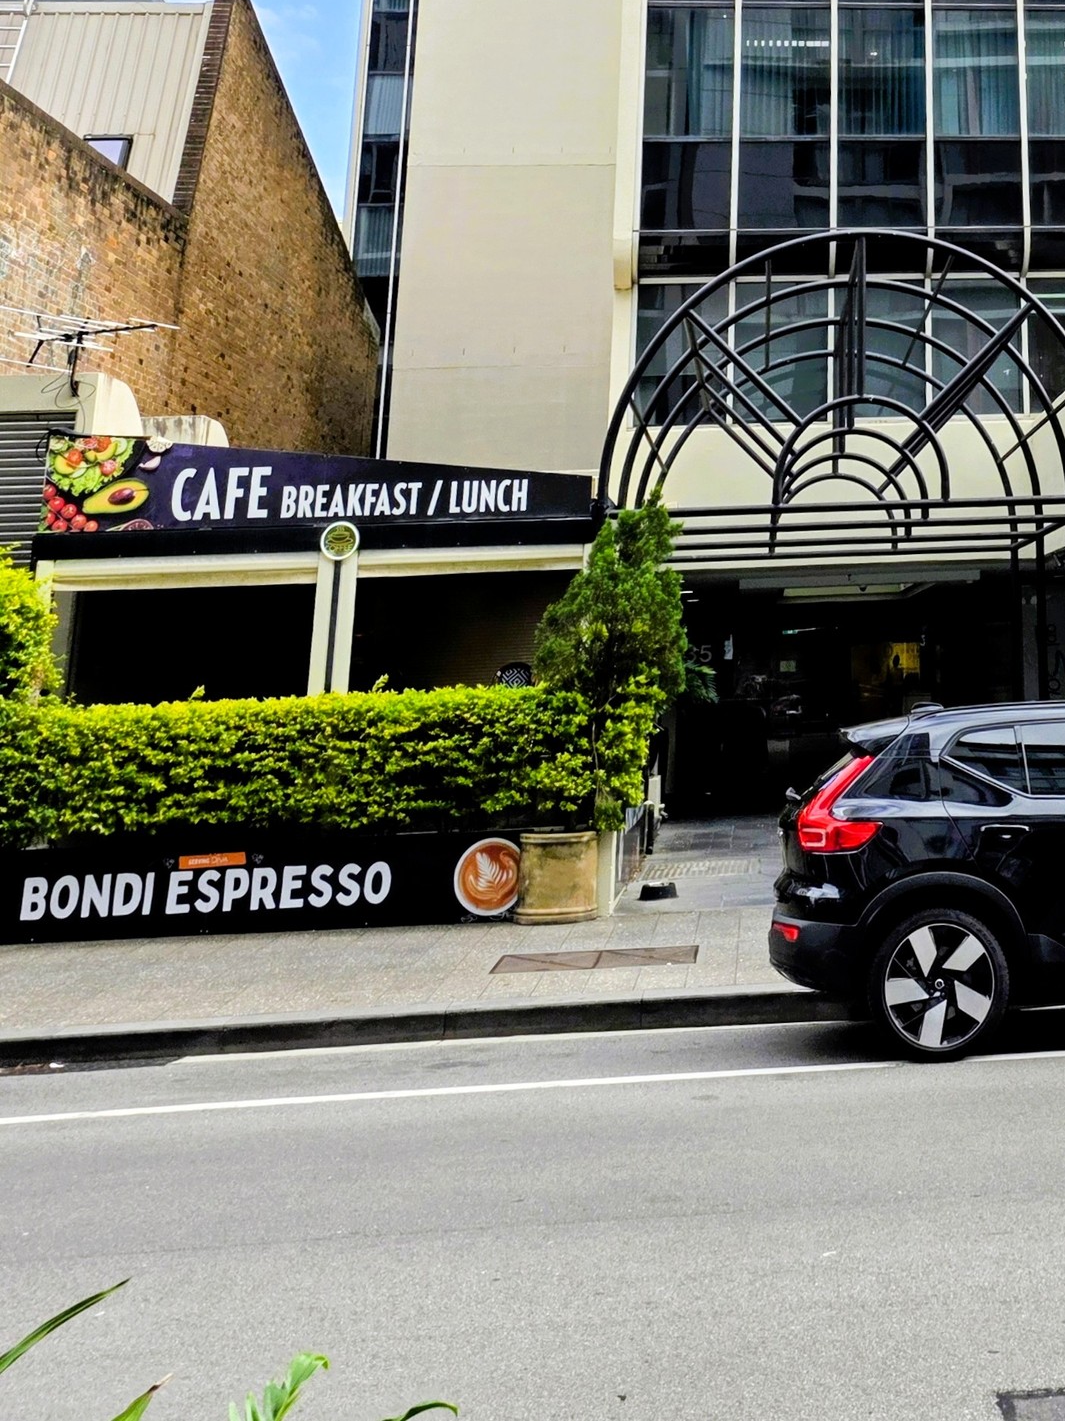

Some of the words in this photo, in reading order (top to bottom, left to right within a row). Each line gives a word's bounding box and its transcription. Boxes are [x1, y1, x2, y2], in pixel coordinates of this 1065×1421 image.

[171, 466, 273, 522] CAFE
[280, 482, 423, 519] BREAKFAST
[449, 478, 529, 514] LUNCH
[19, 872, 155, 921] BONDI
[165, 861, 392, 915] ESPRESSO
